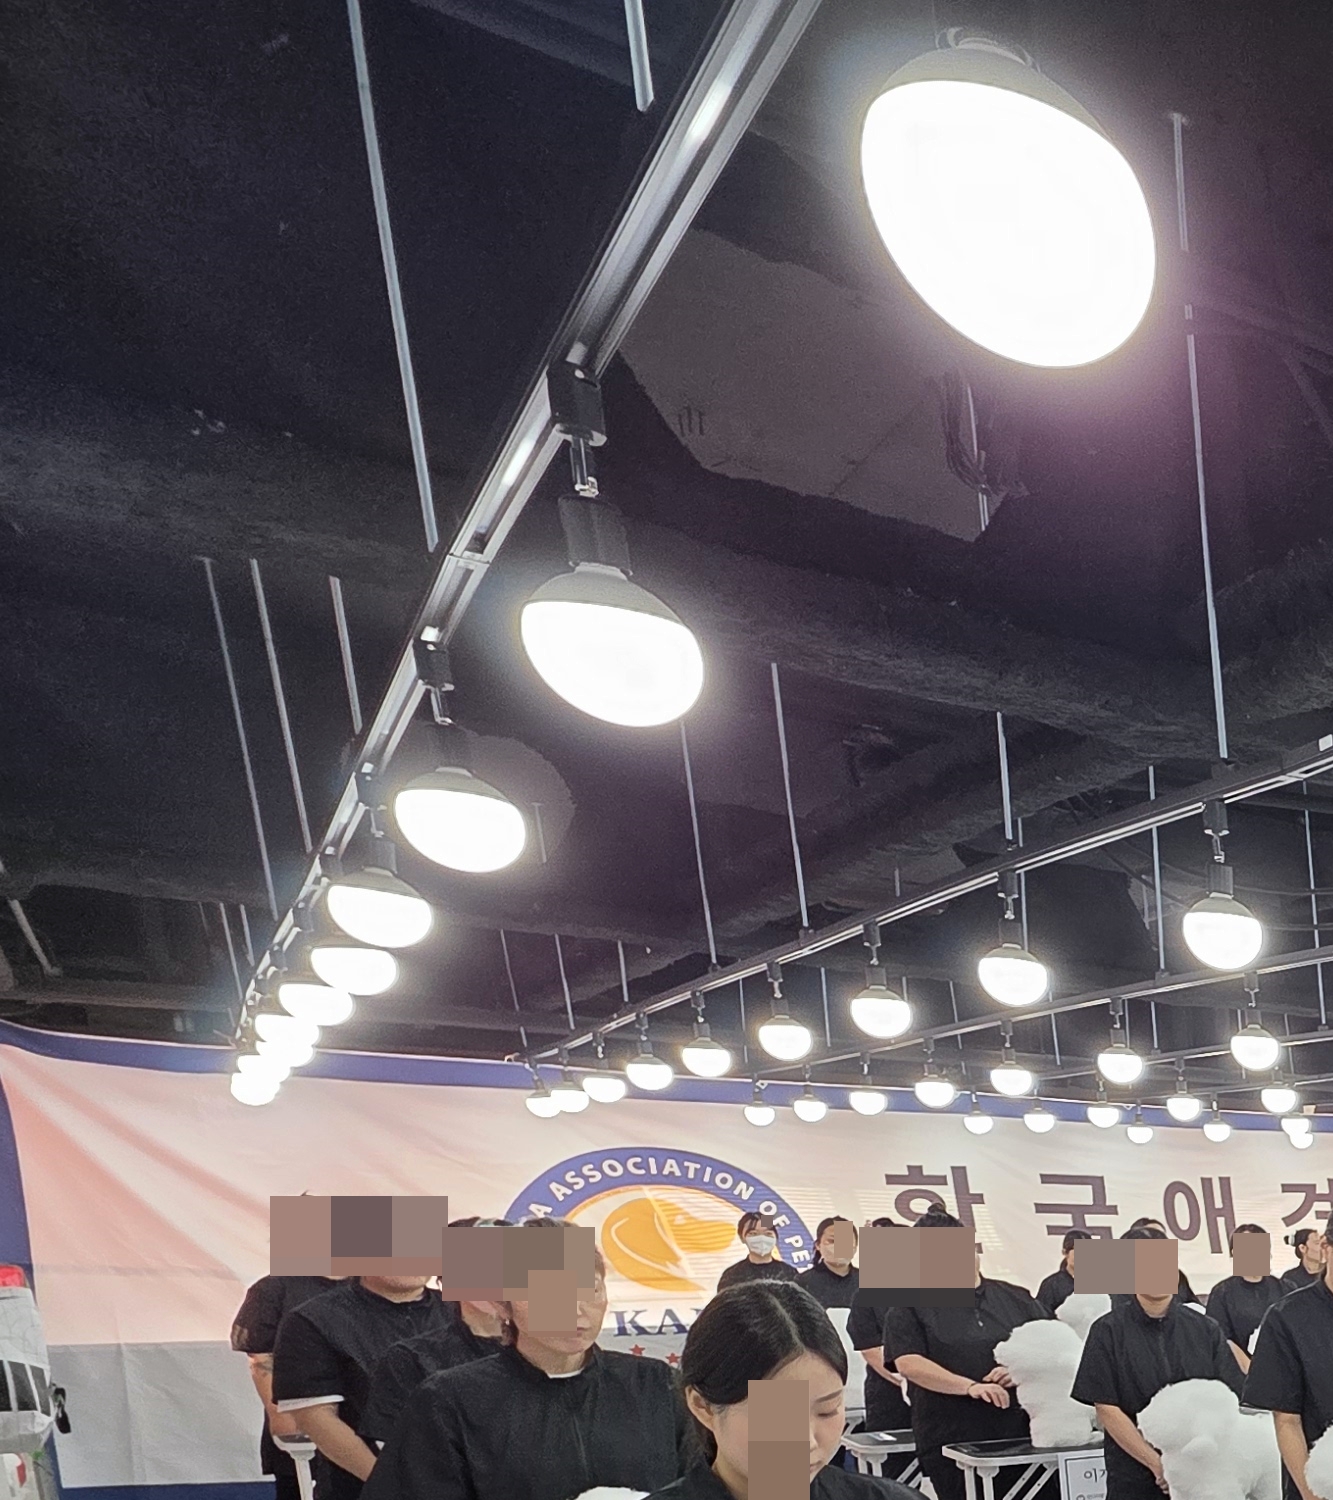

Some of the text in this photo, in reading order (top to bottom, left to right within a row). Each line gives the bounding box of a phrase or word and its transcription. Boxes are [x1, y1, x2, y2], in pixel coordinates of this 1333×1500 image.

[549, 1156, 755, 1201] ASSOCIATION
[759, 1200, 791, 1228] OF
[784, 1234, 814, 1269] PE
[610, 1308, 703, 1337] KA
